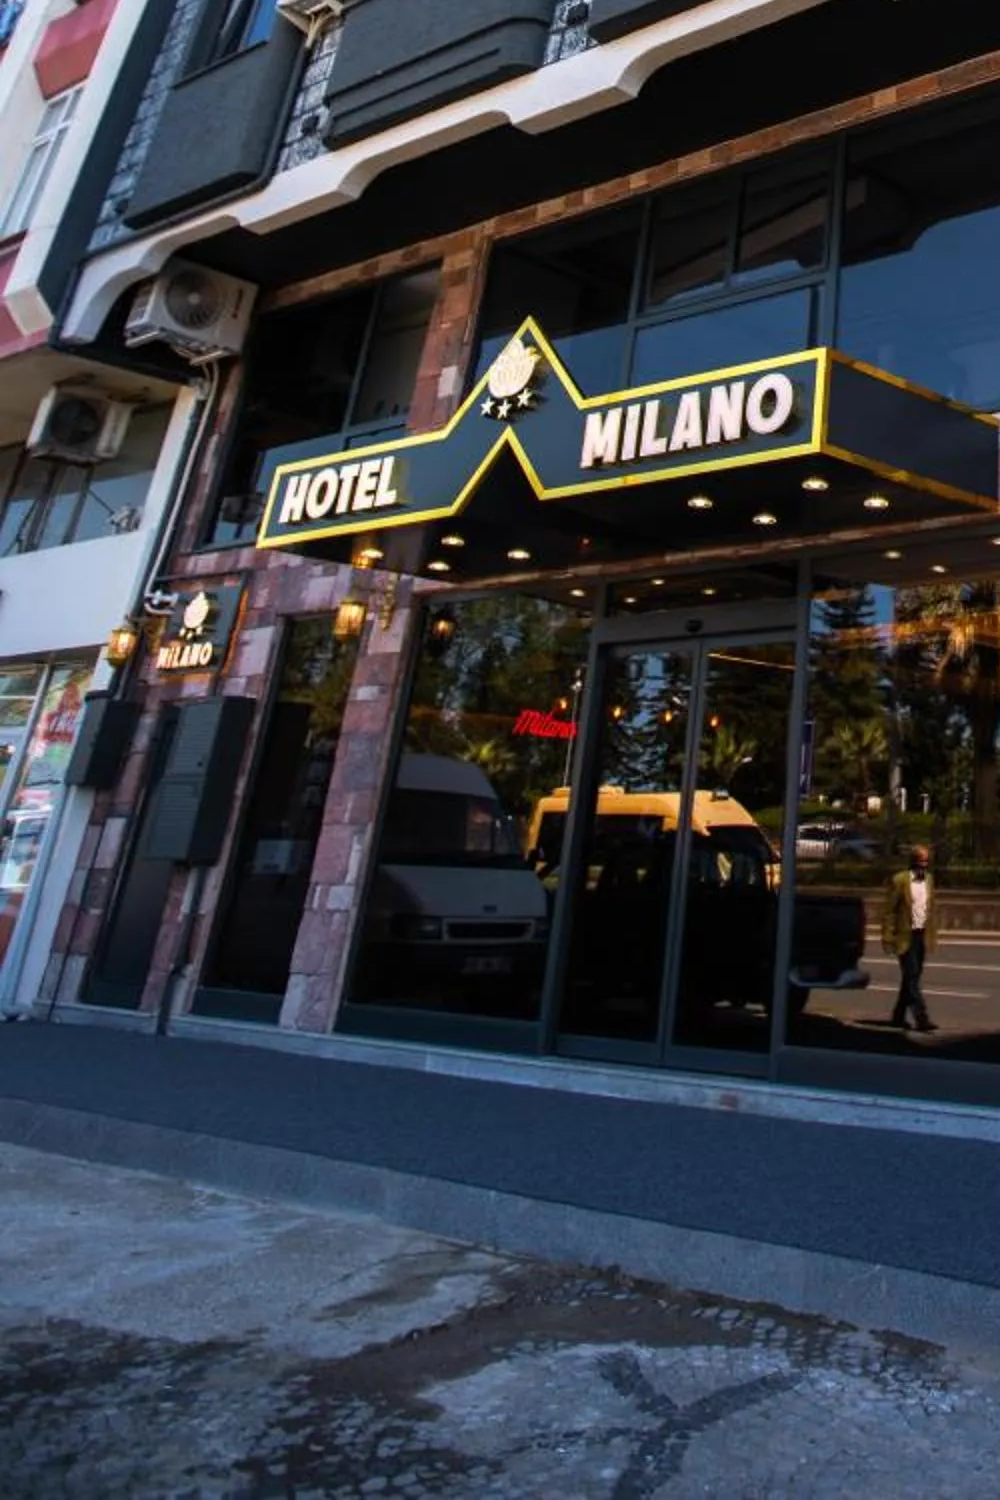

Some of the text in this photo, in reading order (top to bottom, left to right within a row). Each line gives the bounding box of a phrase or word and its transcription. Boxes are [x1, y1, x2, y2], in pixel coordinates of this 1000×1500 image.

[279, 373, 794, 524] HOTEL MILANO
[156, 642, 213, 669] MILANO
